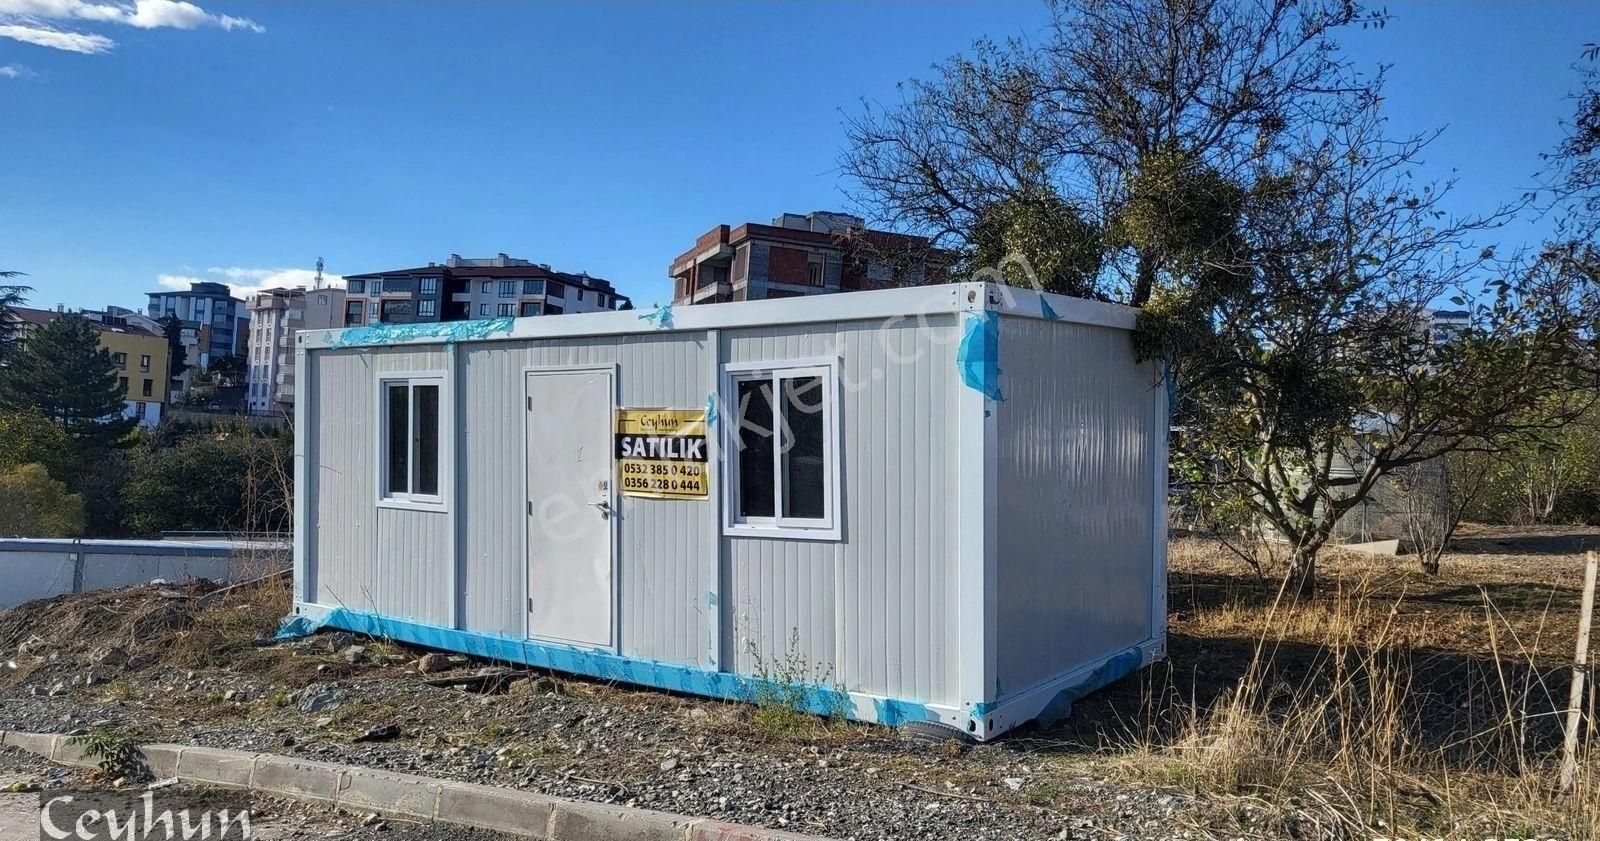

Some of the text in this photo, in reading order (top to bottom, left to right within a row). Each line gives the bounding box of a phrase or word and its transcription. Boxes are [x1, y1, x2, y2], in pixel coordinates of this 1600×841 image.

[640, 414, 679, 430] Ceyhun
[621, 436, 703, 459] SATILIK
[624, 463, 700, 477] 0532 385 0 420
[624, 477, 700, 492] 0356 228 0 444
